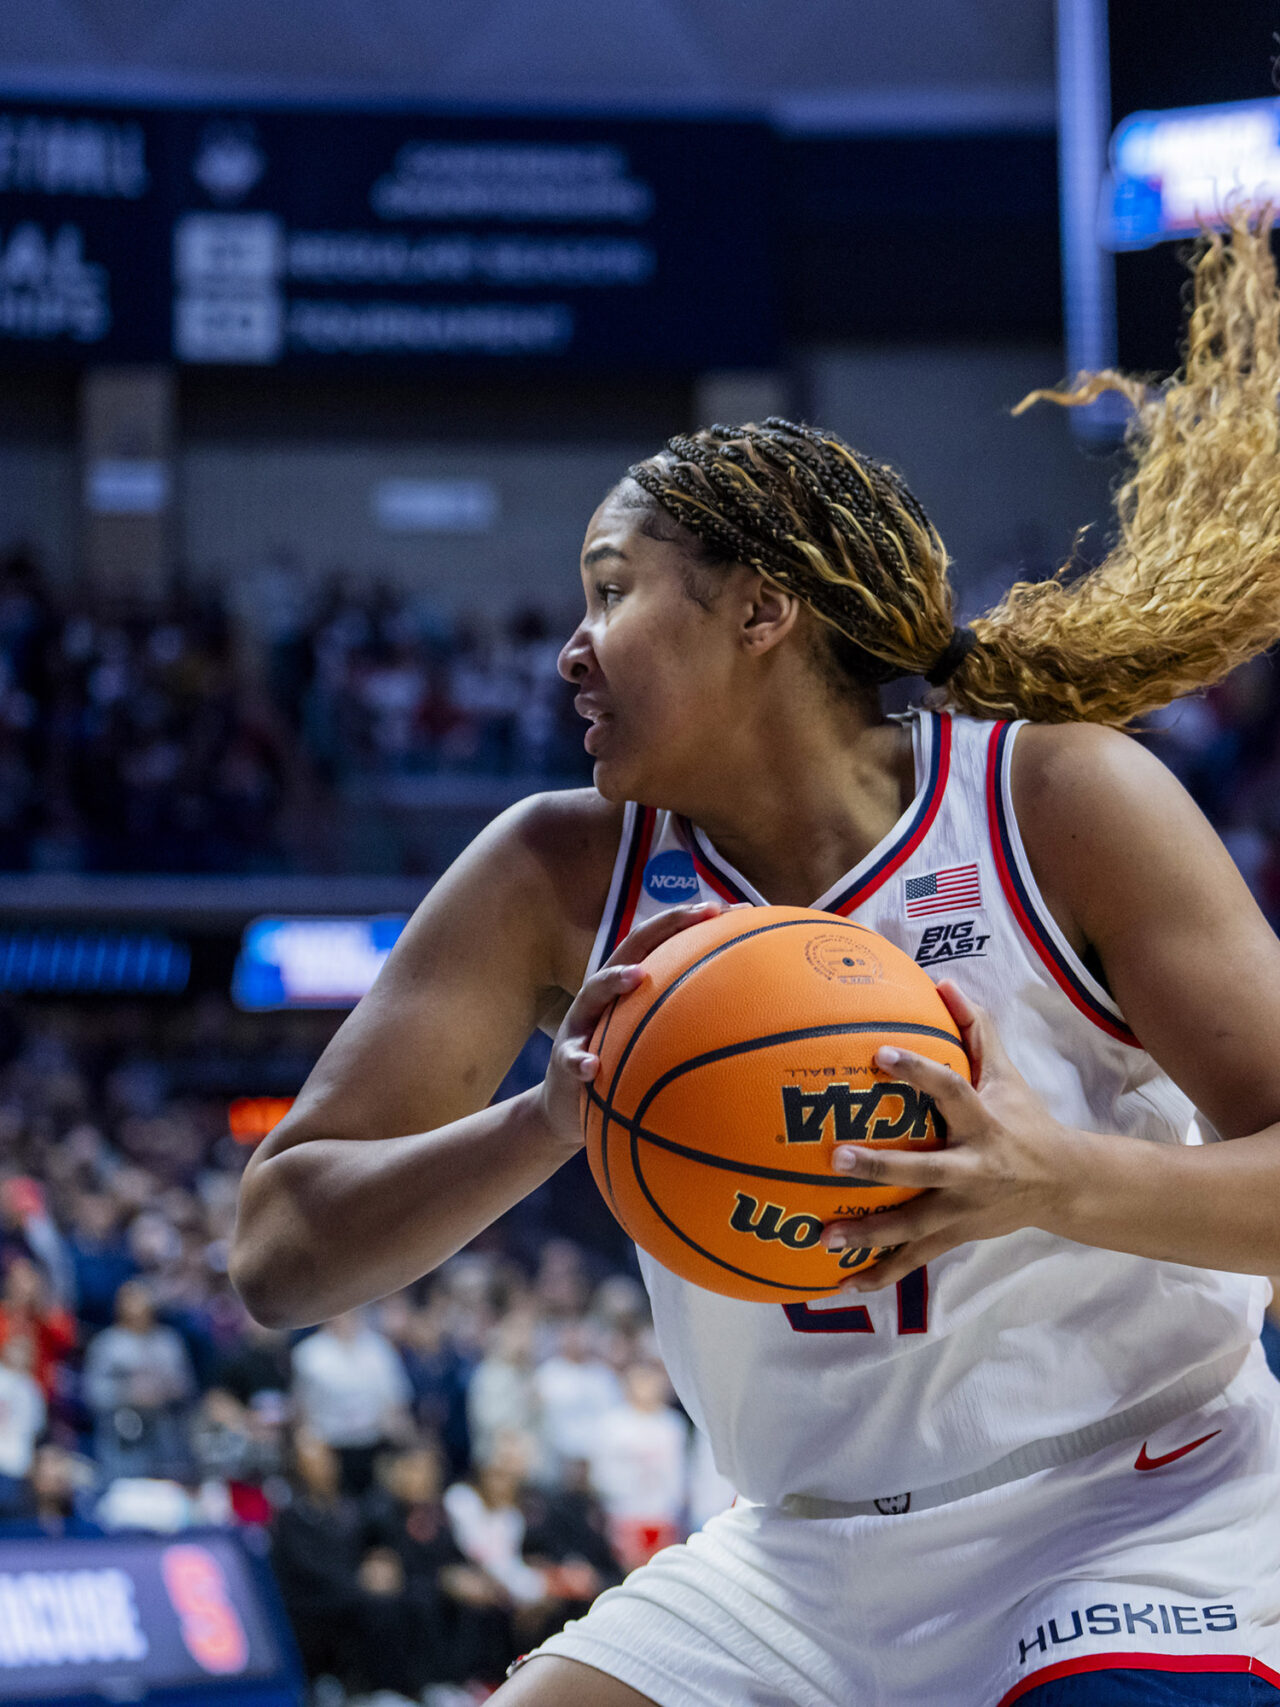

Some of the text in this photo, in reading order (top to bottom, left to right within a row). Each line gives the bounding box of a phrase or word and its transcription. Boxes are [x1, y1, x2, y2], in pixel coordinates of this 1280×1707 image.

[649, 873, 699, 890] NCAA
[920, 920, 975, 945] BIG
[914, 935, 991, 962] EAST
[784, 1065, 837, 1078] BALL
[781, 1080, 948, 1145] NCAA
[1018, 1603, 1239, 1665] HUSKIES
